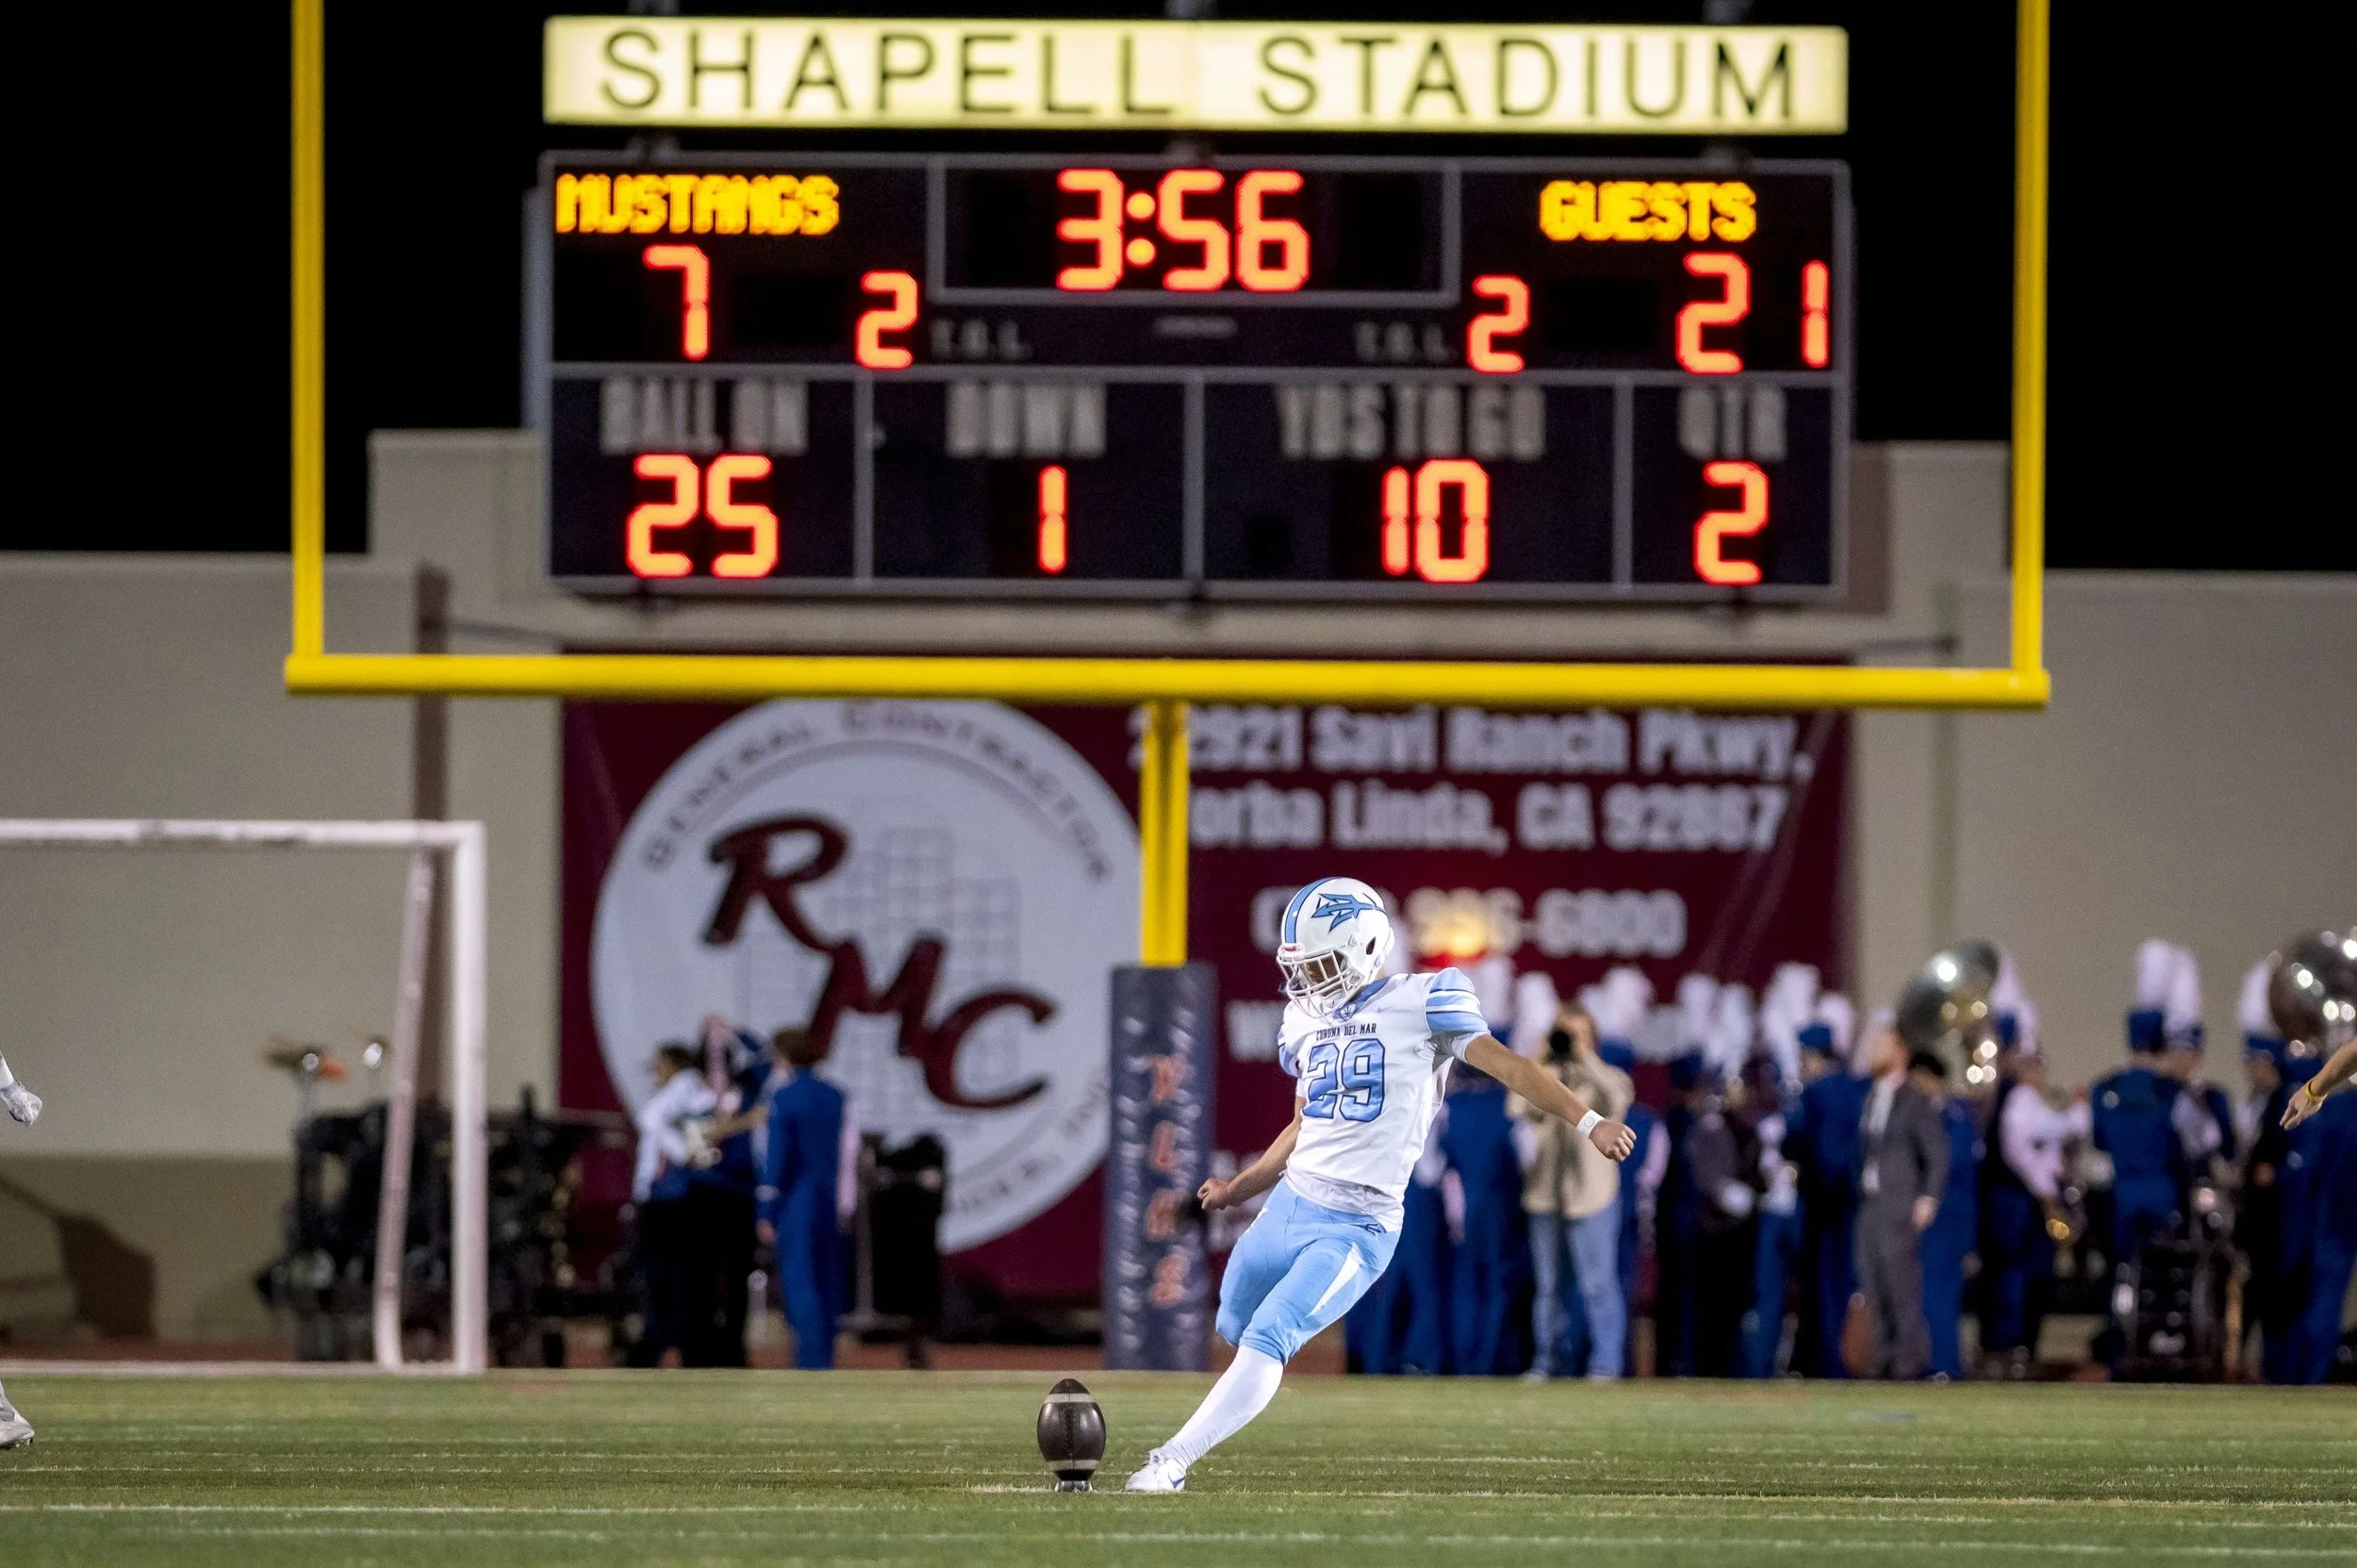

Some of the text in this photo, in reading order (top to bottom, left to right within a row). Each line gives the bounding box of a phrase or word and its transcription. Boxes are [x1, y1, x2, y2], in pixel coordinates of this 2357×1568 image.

[599, 27, 1792, 120] SHAPELL STADIUM
[556, 173, 839, 235] MUSTANGS
[1056, 168, 1310, 292] 3:56
[1540, 180, 1756, 241] GUESTS
[643, 245, 710, 360] 7
[854, 271, 917, 369] 2
[1466, 275, 1529, 373] 2
[626, 454, 778, 578] 25
[1039, 465, 1066, 573] 1
[1382, 458, 1489, 583] 10
[1694, 460, 1769, 586] 2
[1187, 780, 1325, 848] orba
[1343, 1024, 1357, 1036] DEL
[1360, 1022, 1377, 1034] MAR
[1302, 1038, 1386, 1122] 29
